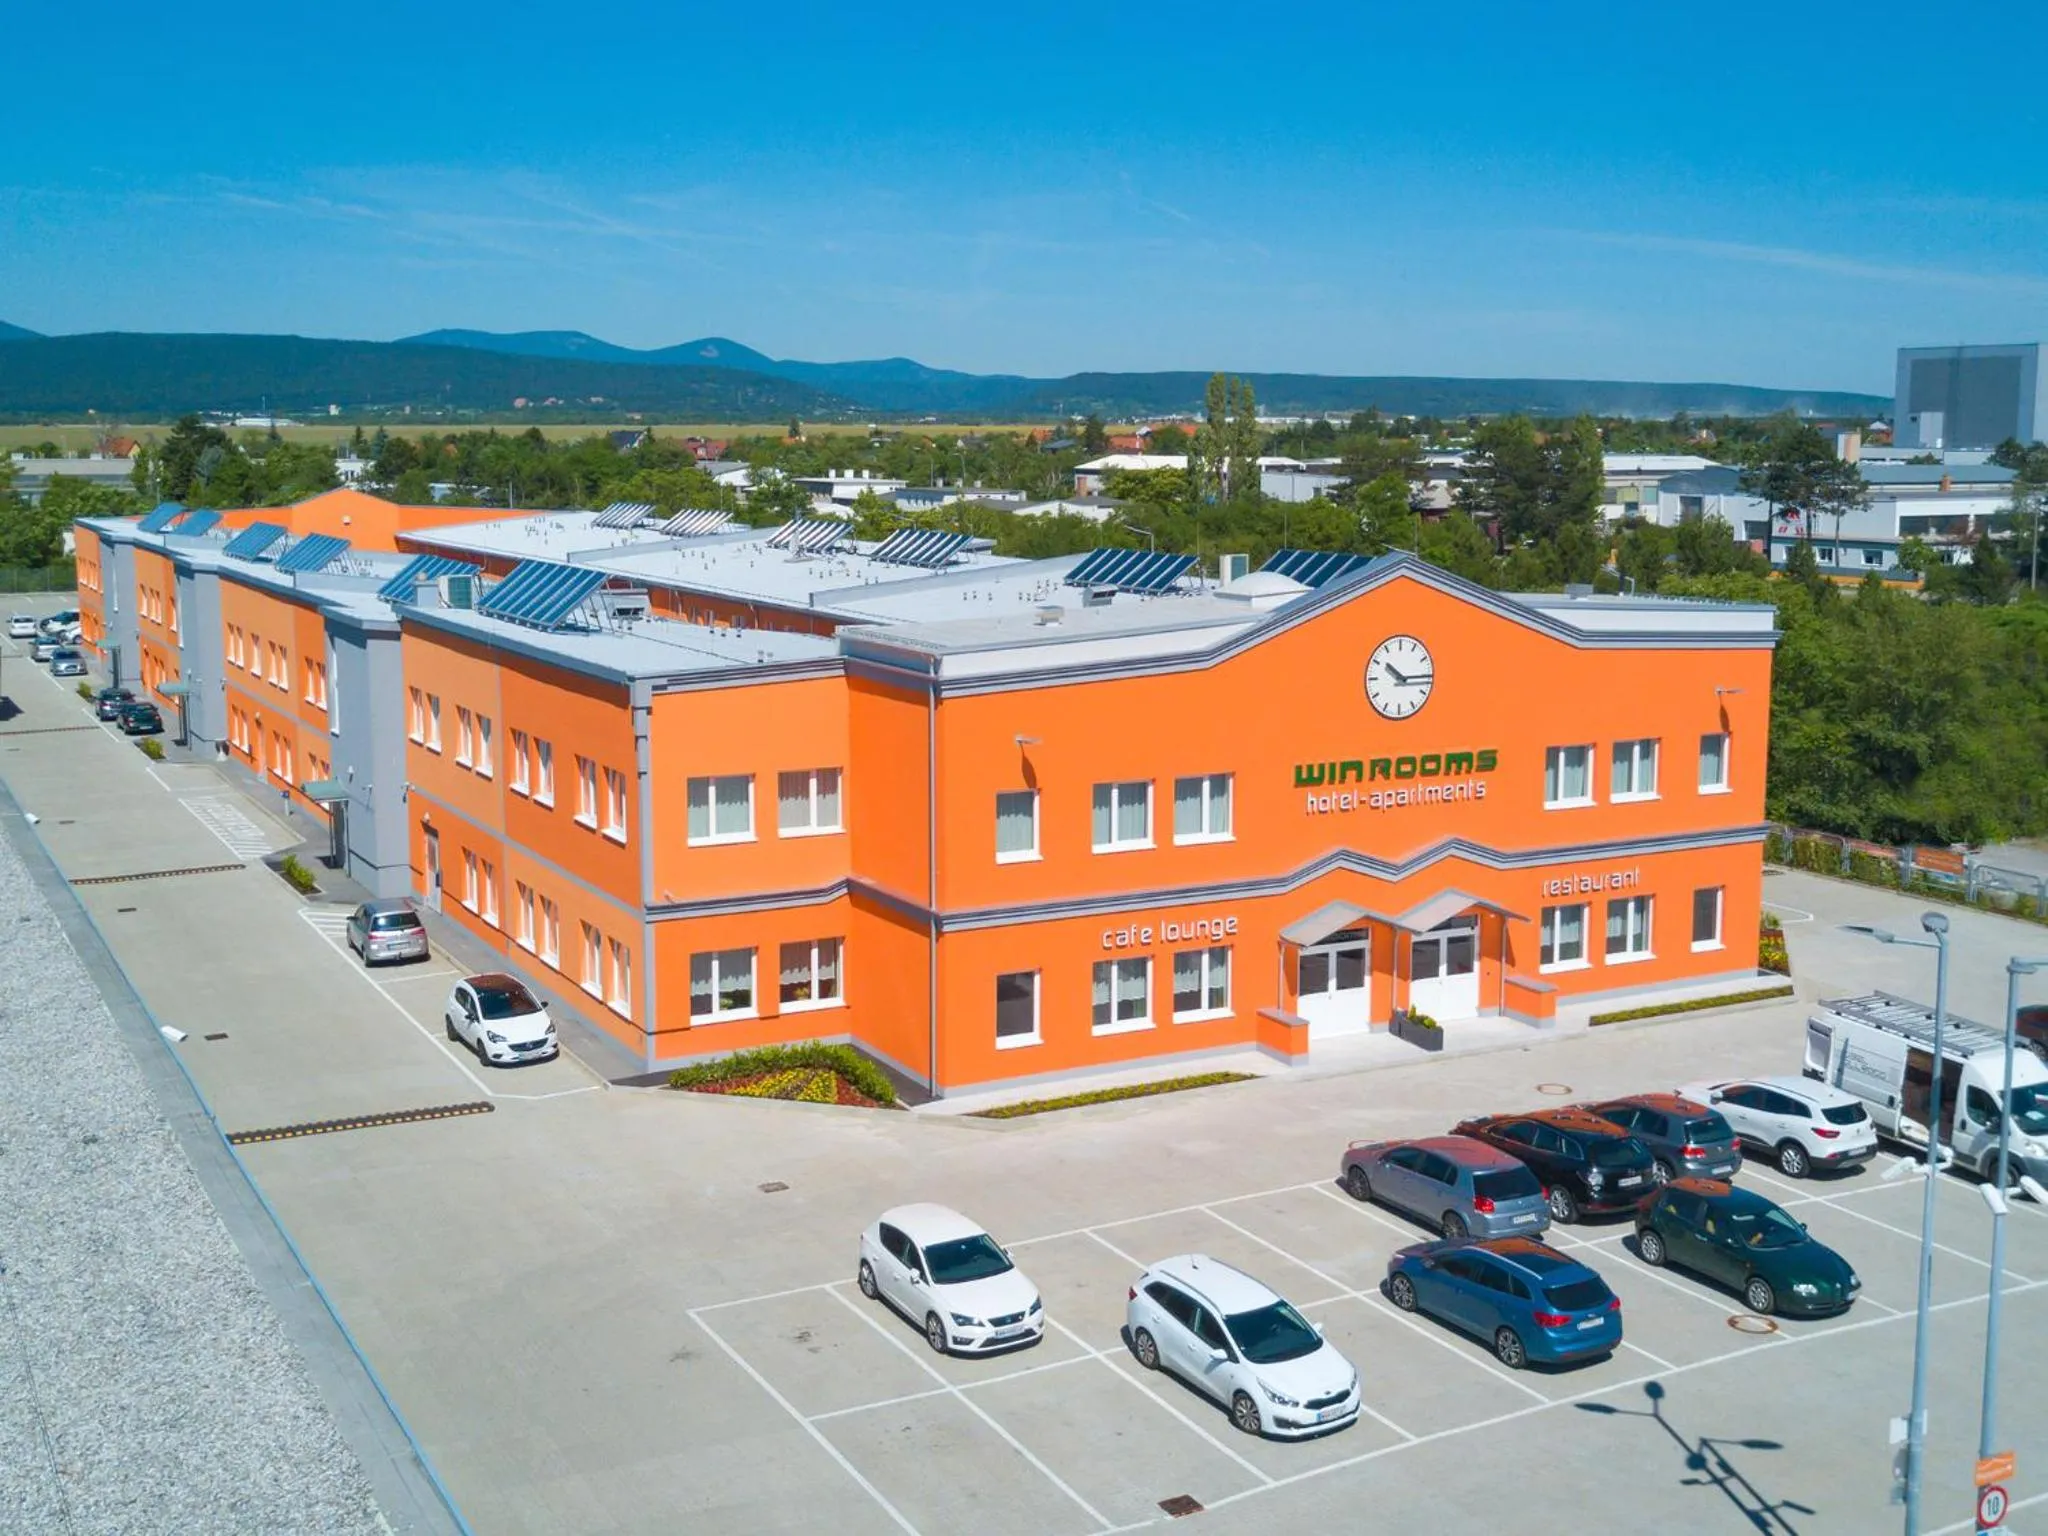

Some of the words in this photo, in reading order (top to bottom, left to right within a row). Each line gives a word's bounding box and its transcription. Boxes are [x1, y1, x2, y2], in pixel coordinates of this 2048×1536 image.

[1306, 779, 1486, 813] hotel-apartments
[1542, 865, 1639, 896] restaurant
[1103, 924, 1152, 948] cafe
[1161, 917, 1238, 942] lounge
[1987, 1496, 2000, 1516] 10
